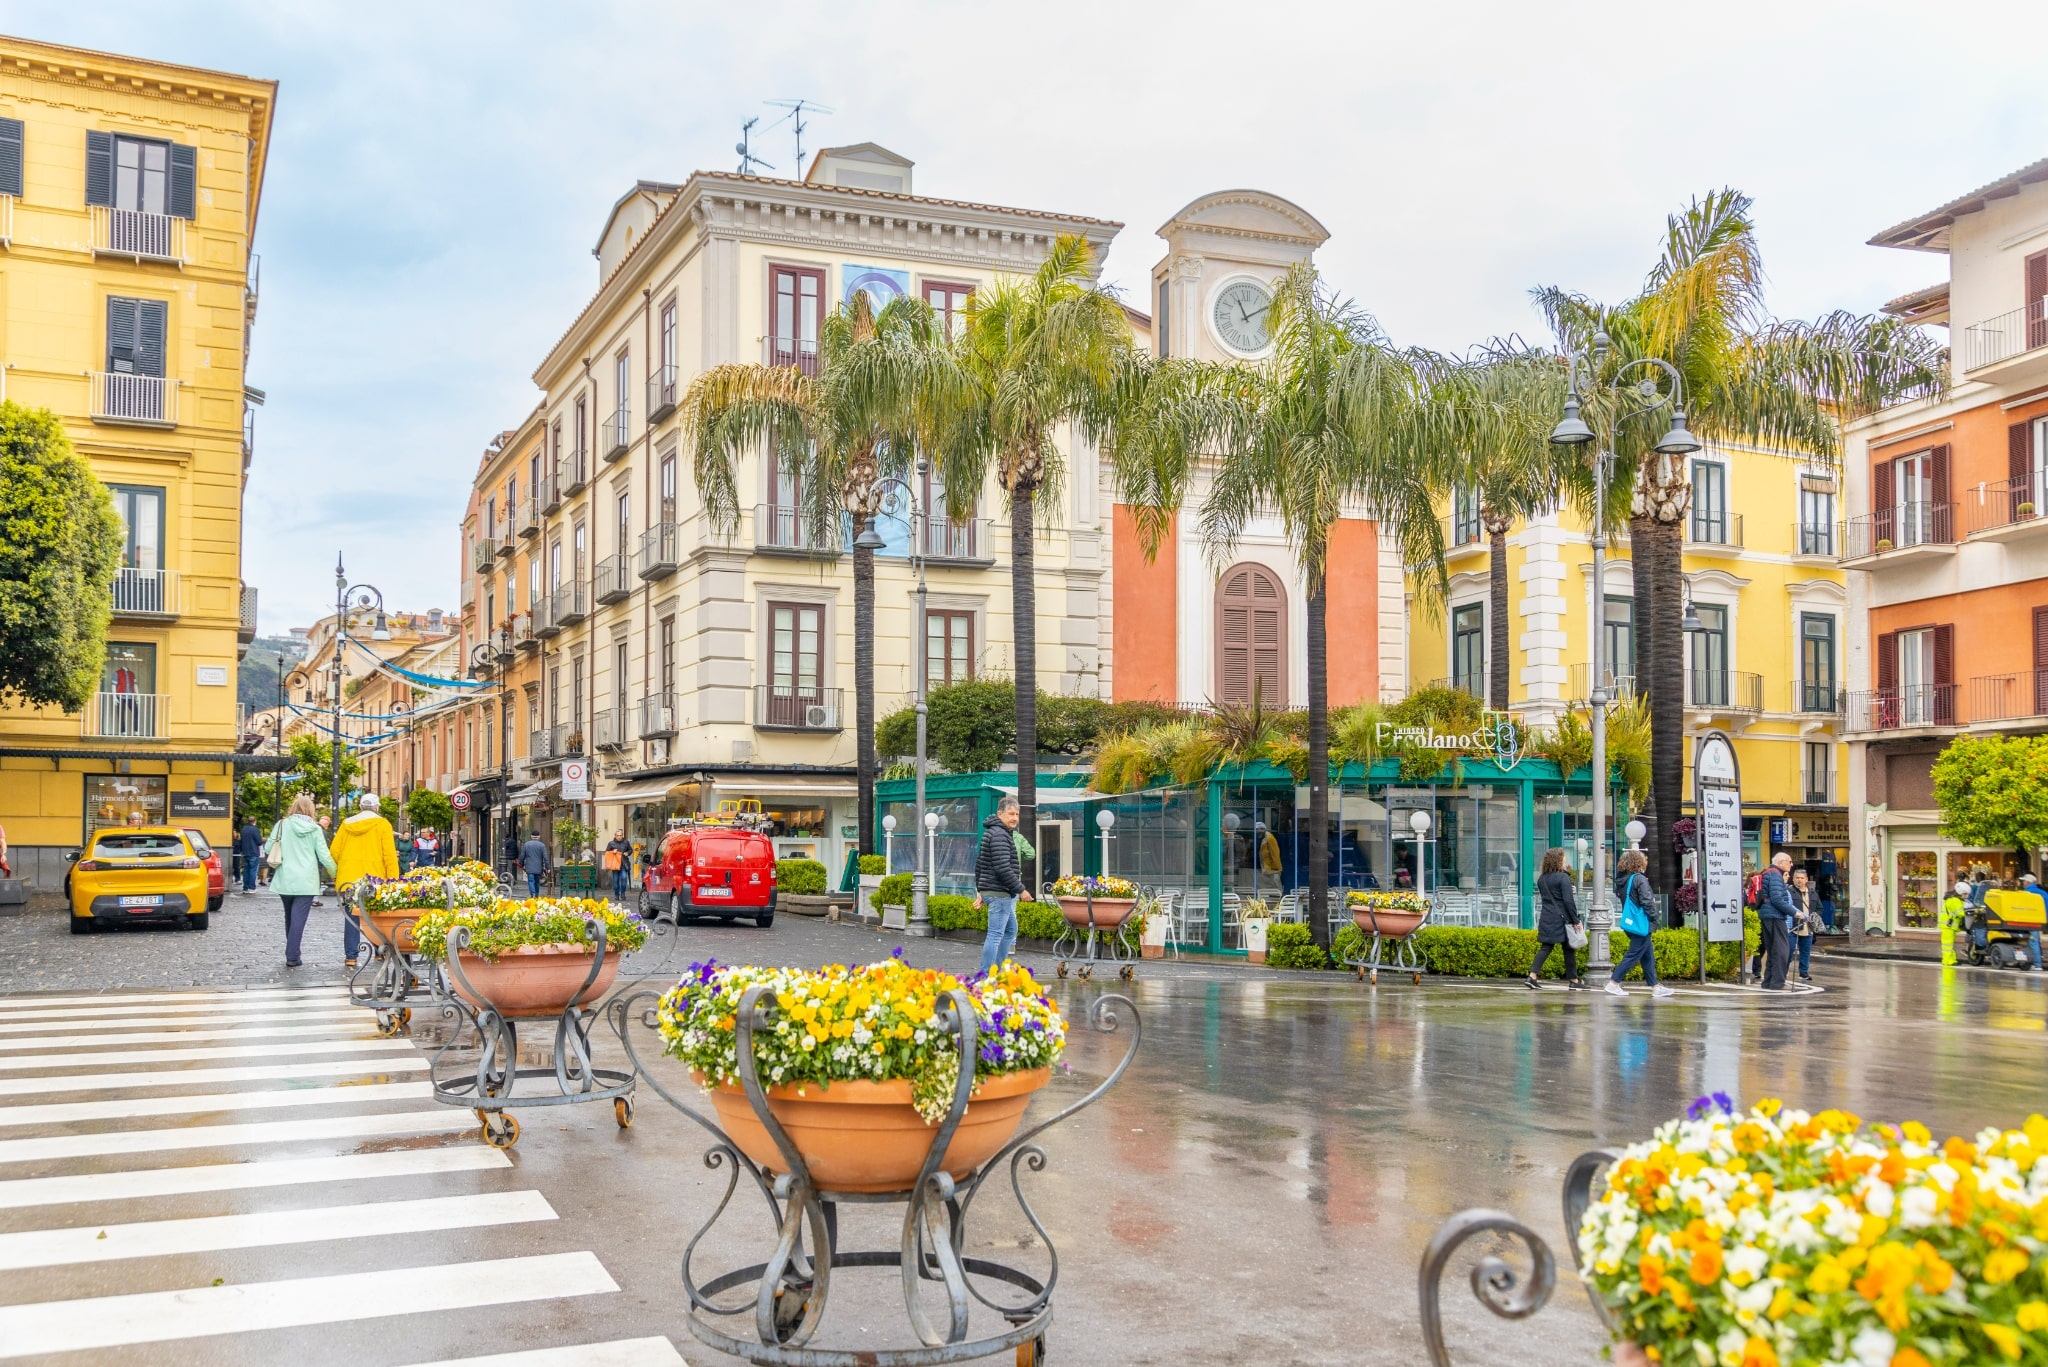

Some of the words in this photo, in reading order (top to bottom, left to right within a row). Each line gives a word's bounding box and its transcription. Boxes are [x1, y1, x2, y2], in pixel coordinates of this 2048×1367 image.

[91, 794, 126, 802] Harmont
[456, 795, 466, 804] 20
[1772, 821, 1783, 835] T
